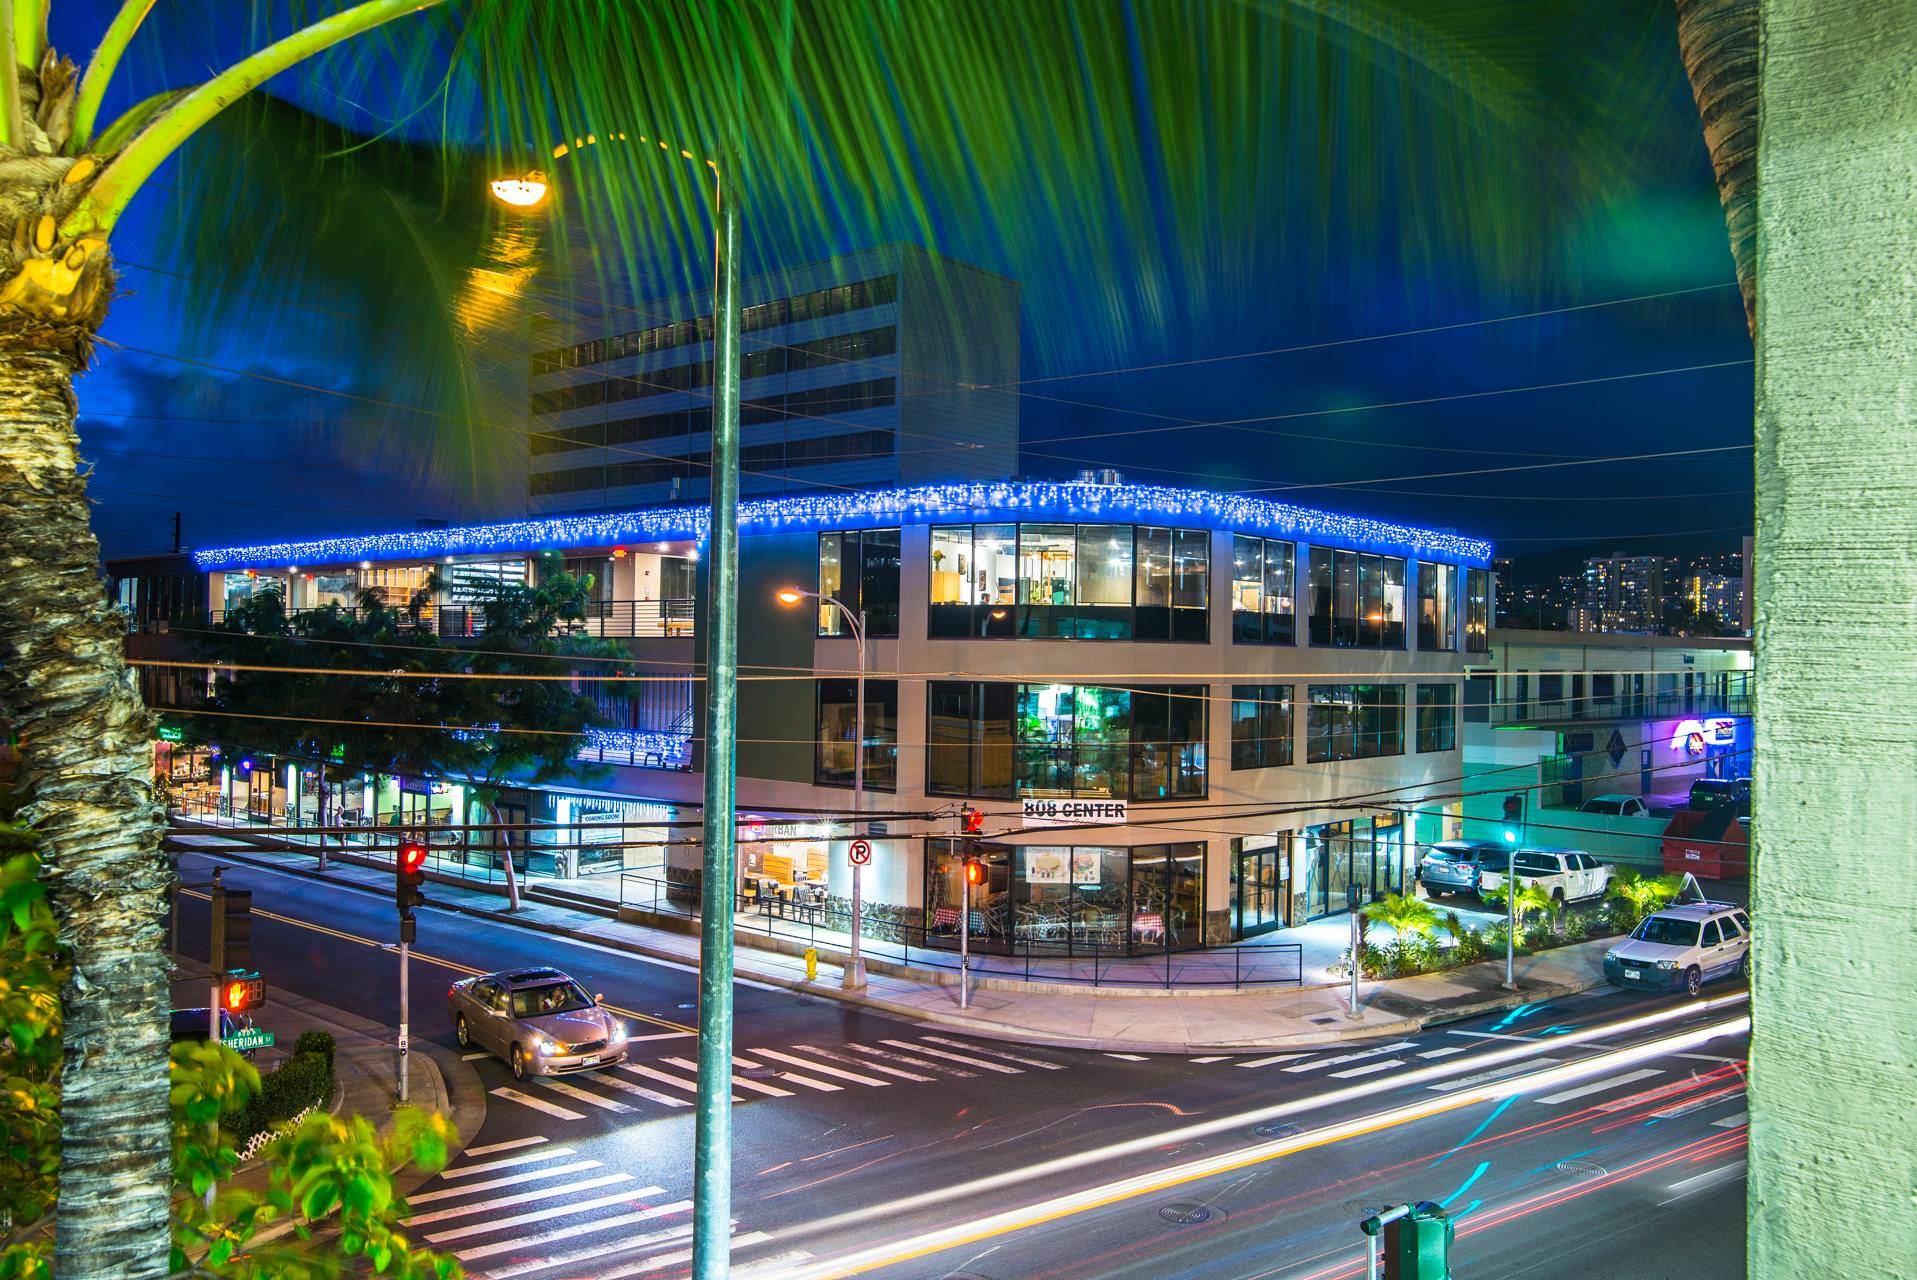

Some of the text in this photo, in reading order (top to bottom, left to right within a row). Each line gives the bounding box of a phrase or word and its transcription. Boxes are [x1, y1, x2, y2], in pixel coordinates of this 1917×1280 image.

[1024, 800, 1125, 818] 808 CENTER
[222, 1035, 264, 1049] SHERIDAN
